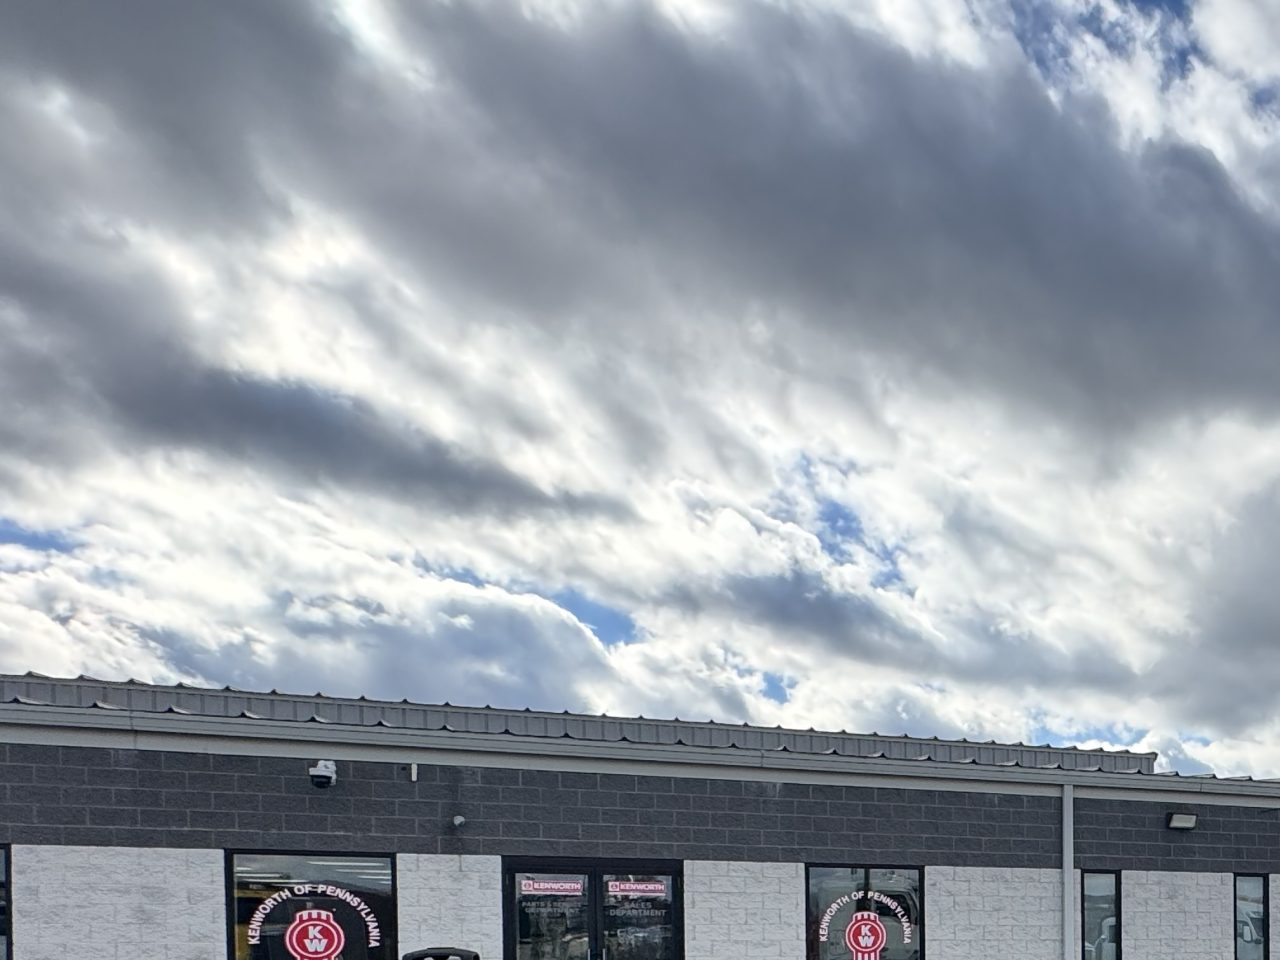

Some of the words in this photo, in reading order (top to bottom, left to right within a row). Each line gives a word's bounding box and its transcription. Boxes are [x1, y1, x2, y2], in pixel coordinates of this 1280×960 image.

[533, 881, 581, 890] KENWORTH
[620, 883, 665, 891] KENWORTH
[624, 901, 652, 909] SALES
[248, 889, 292, 945] KENWORTH
[293, 884, 312, 895] OF
[317, 884, 381, 948] PENNSYLVANIA
[609, 909, 666, 917] DEPARTMENT
[819, 895, 850, 942] KENWORTH
[851, 890, 865, 900] OF
[867, 891, 912, 944] PENNSYLVANIA
